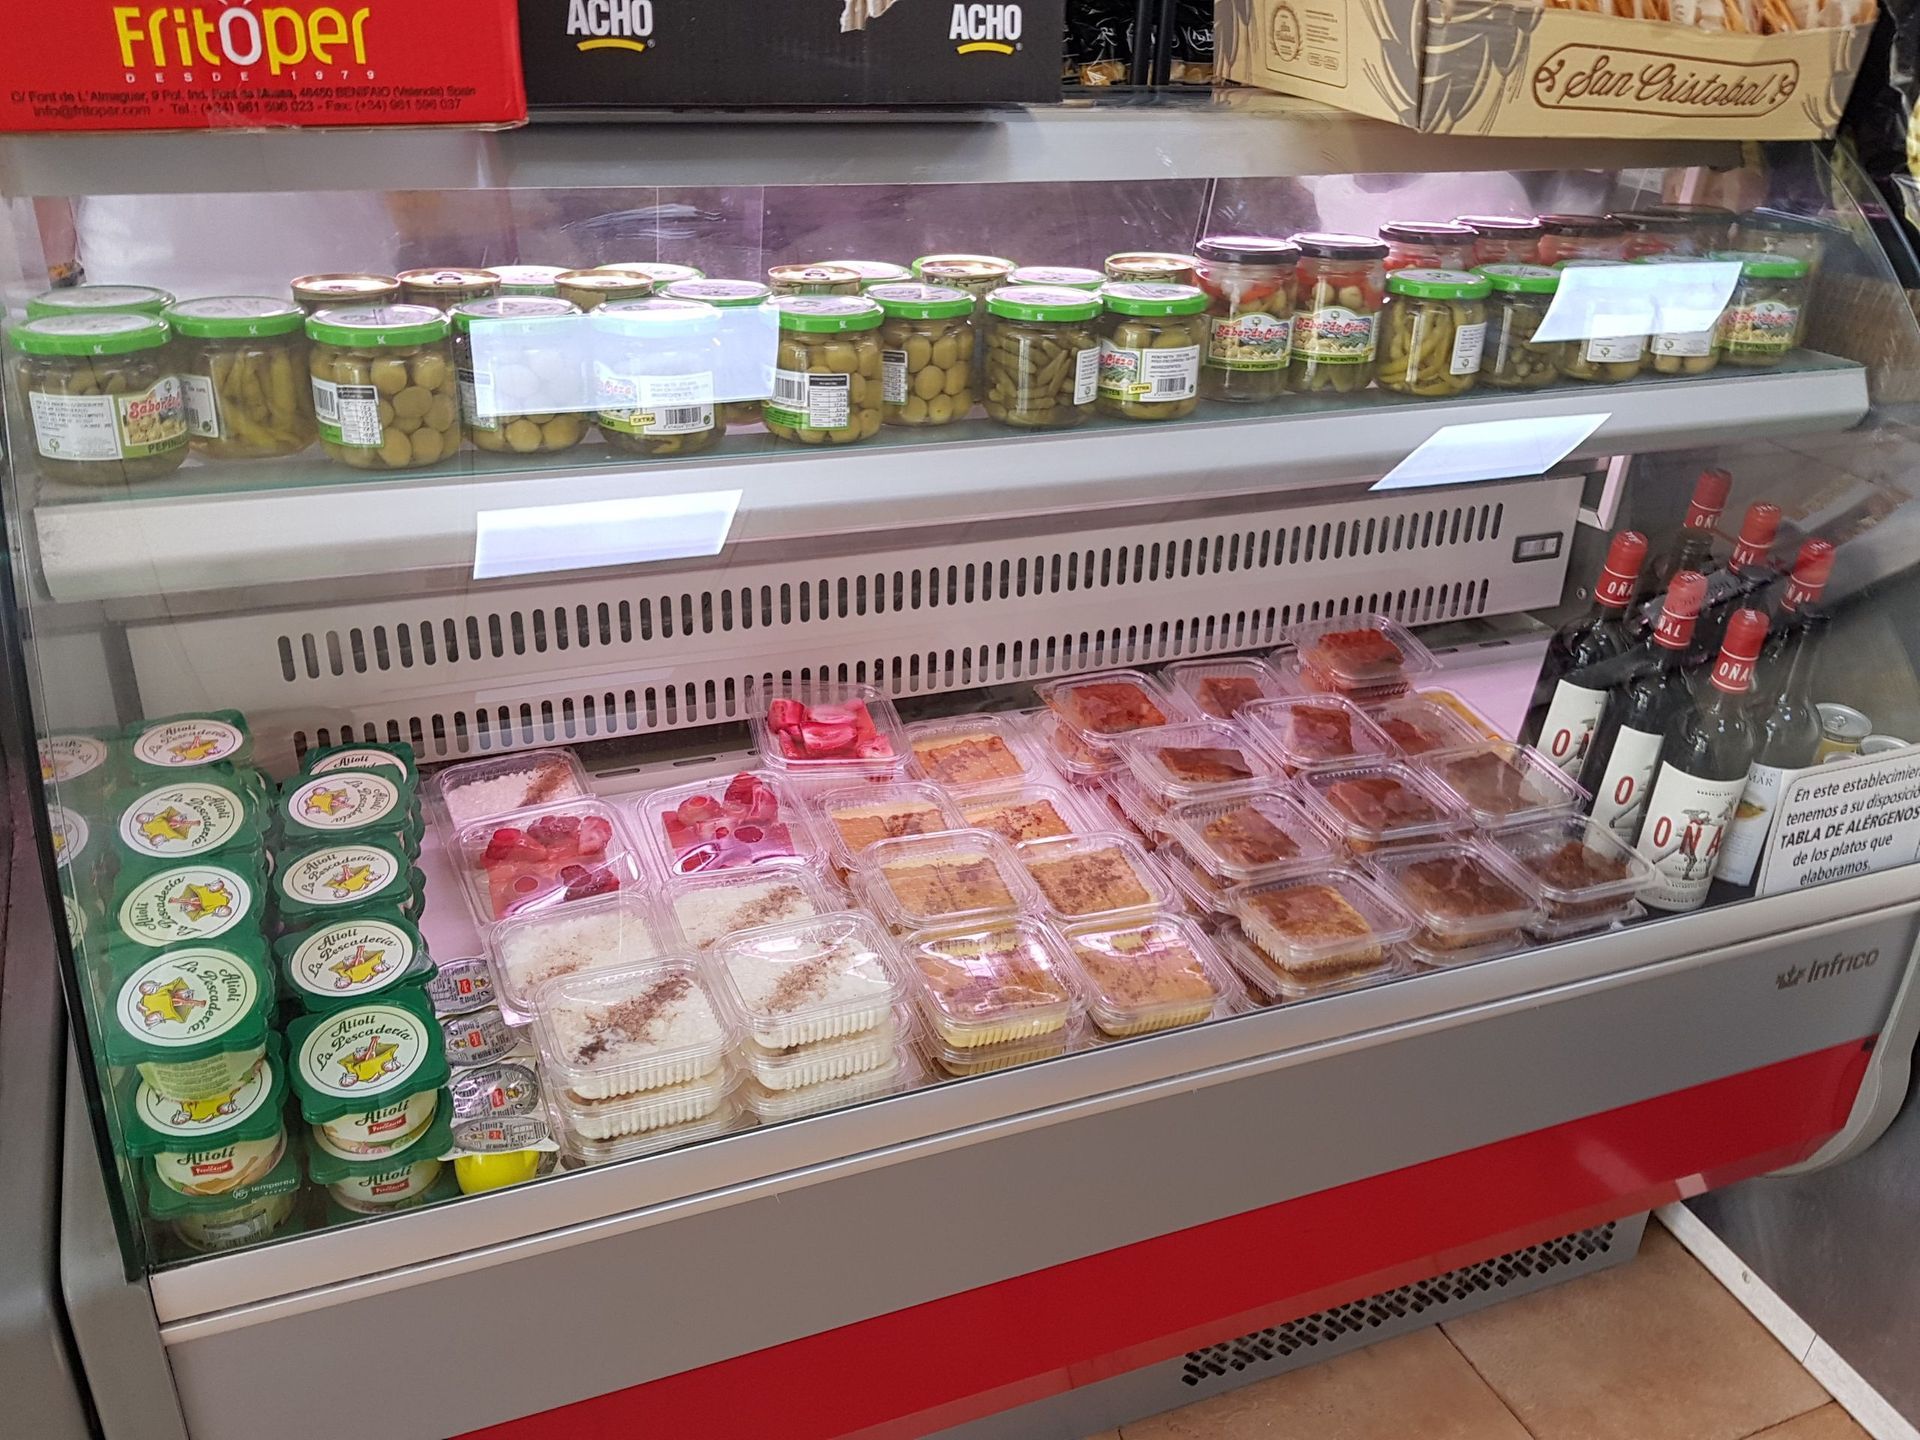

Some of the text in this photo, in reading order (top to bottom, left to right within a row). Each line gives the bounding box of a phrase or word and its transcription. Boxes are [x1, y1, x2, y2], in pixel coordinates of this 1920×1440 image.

[566, 0, 653, 36] ACHO
[949, 4, 1022, 40] ACHO
[125, 70, 375, 83] DESDE 1979
[1558, 54, 1778, 107] San Cristobal
[1794, 787, 1810, 803] En
[1813, 781, 1840, 799] este
[1786, 805, 1838, 826] tenemos
[1840, 804, 1848, 815] a
[1850, 801, 1864, 814] su
[1780, 827, 1821, 850] TABLA
[1825, 822, 1845, 839] DE
[1792, 834, 1893, 867] de los platos que
[303, 854, 338, 875] Alioli
[135, 902, 157, 931] Alioli
[317, 928, 359, 951] Alioli
[172, 960, 199, 974] La
[307, 962, 324, 979] La
[218, 968, 242, 1003] Alioli
[330, 1015, 376, 1038] Alioli
[316, 1052, 334, 1071] La
[354, 1099, 410, 1126] Alioli
[176, 1146, 236, 1166] Alioli
[358, 1165, 413, 1187] Alioli
